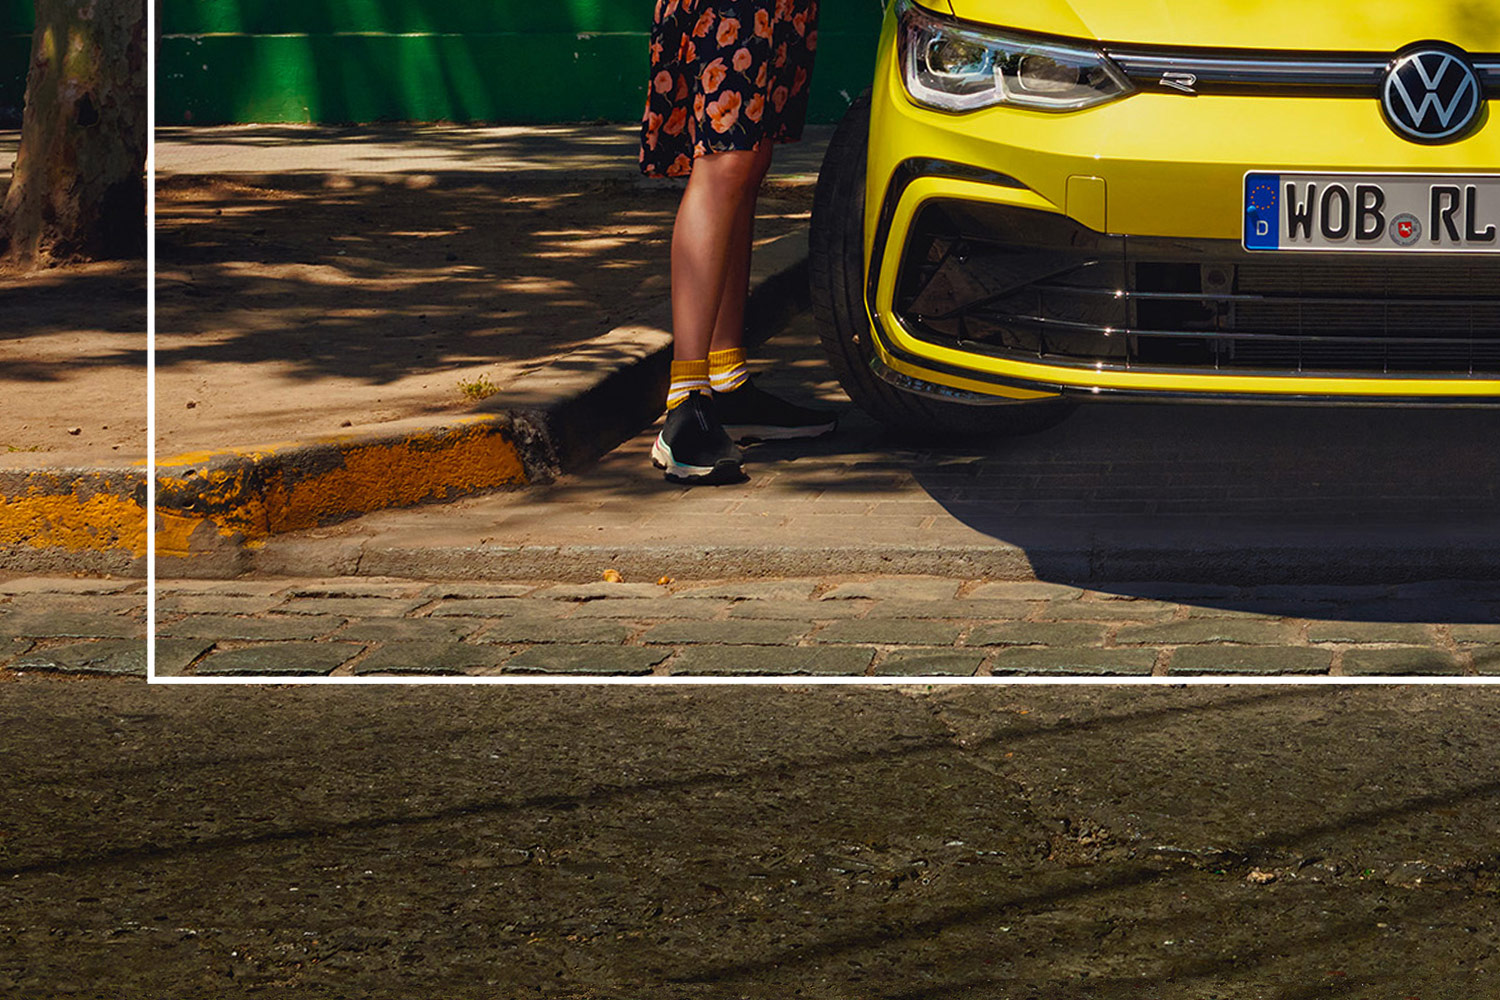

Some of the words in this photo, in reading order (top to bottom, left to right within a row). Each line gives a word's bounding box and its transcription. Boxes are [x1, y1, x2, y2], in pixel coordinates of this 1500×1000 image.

[1388, 52, 1475, 133] VW
[1256, 219, 1269, 236] D
[1285, 182, 1386, 241] WOB
[1429, 184, 1496, 242] RL
